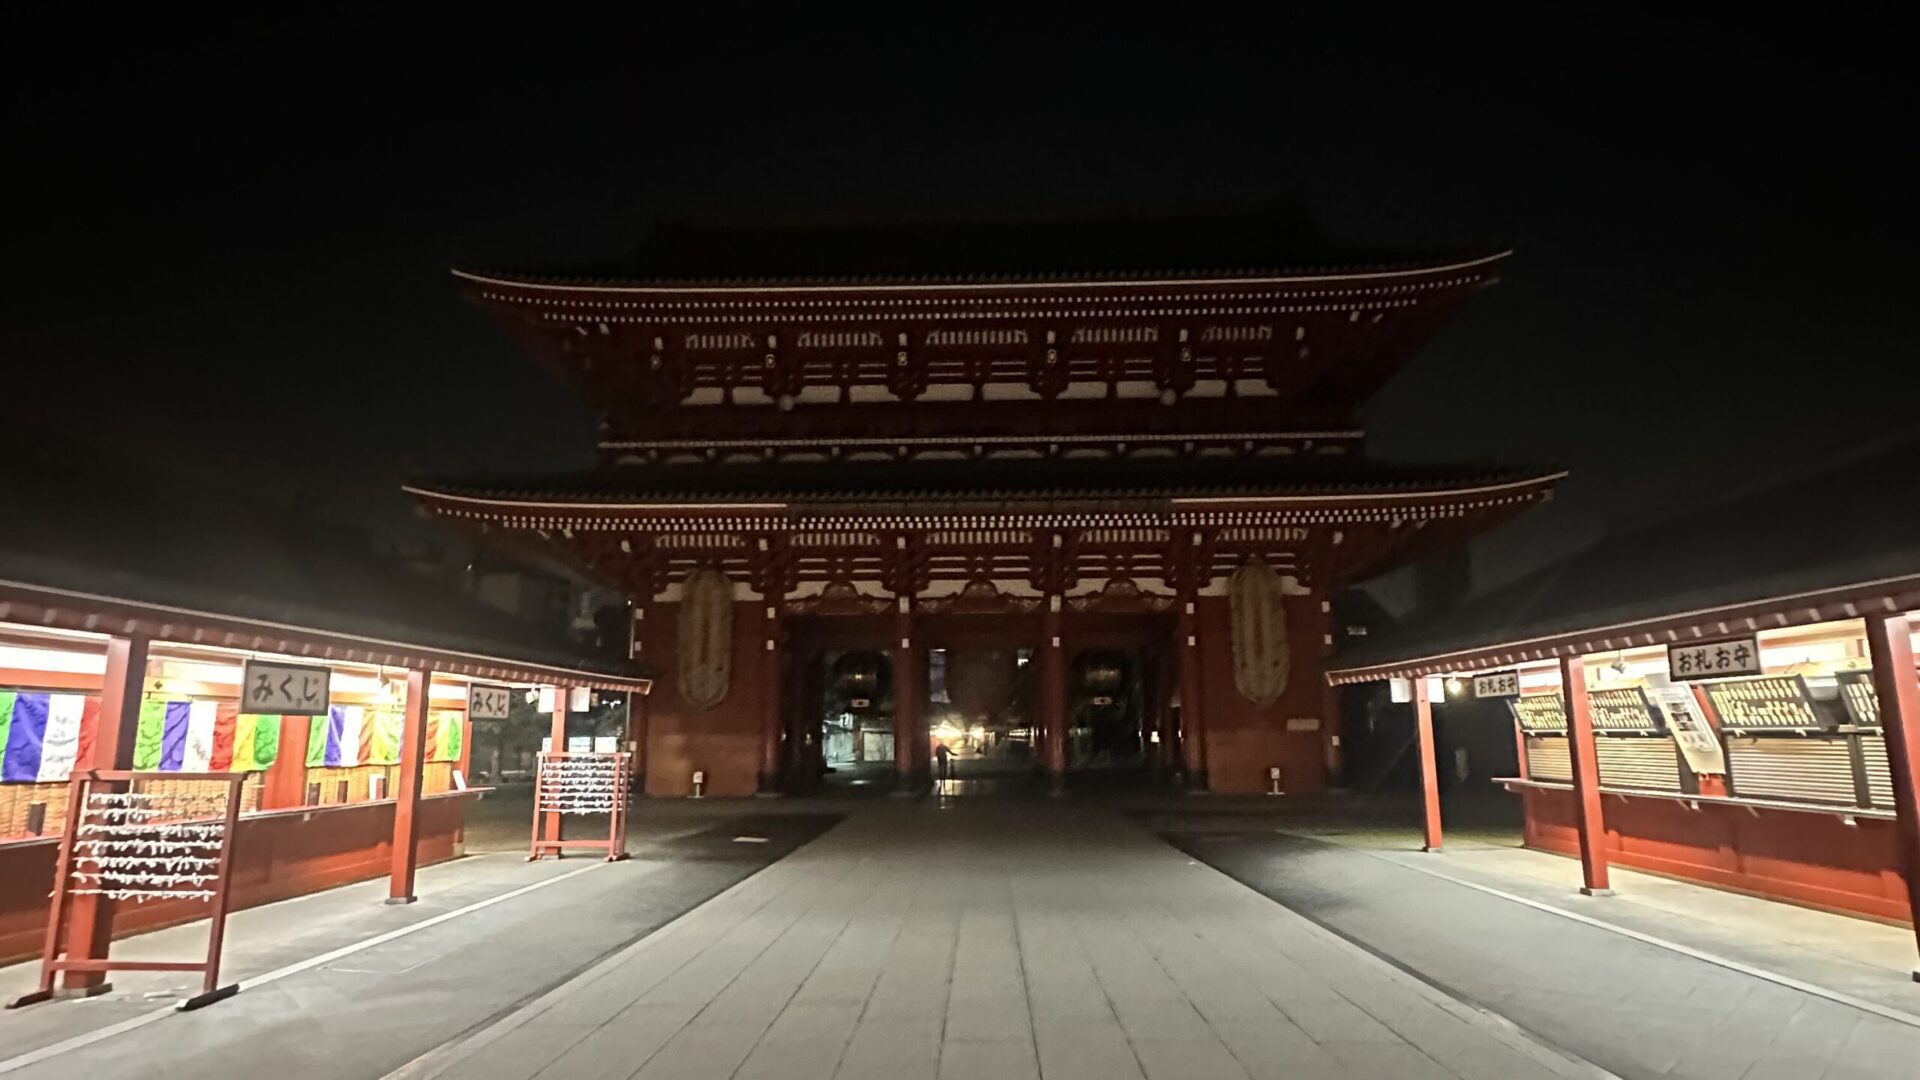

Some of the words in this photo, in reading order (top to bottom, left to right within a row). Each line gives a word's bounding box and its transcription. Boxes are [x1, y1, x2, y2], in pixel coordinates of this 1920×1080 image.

[1678, 643, 1751, 673] お札お守
[253, 673, 319, 703] みくじ
[473, 691, 506, 713] みくじ
